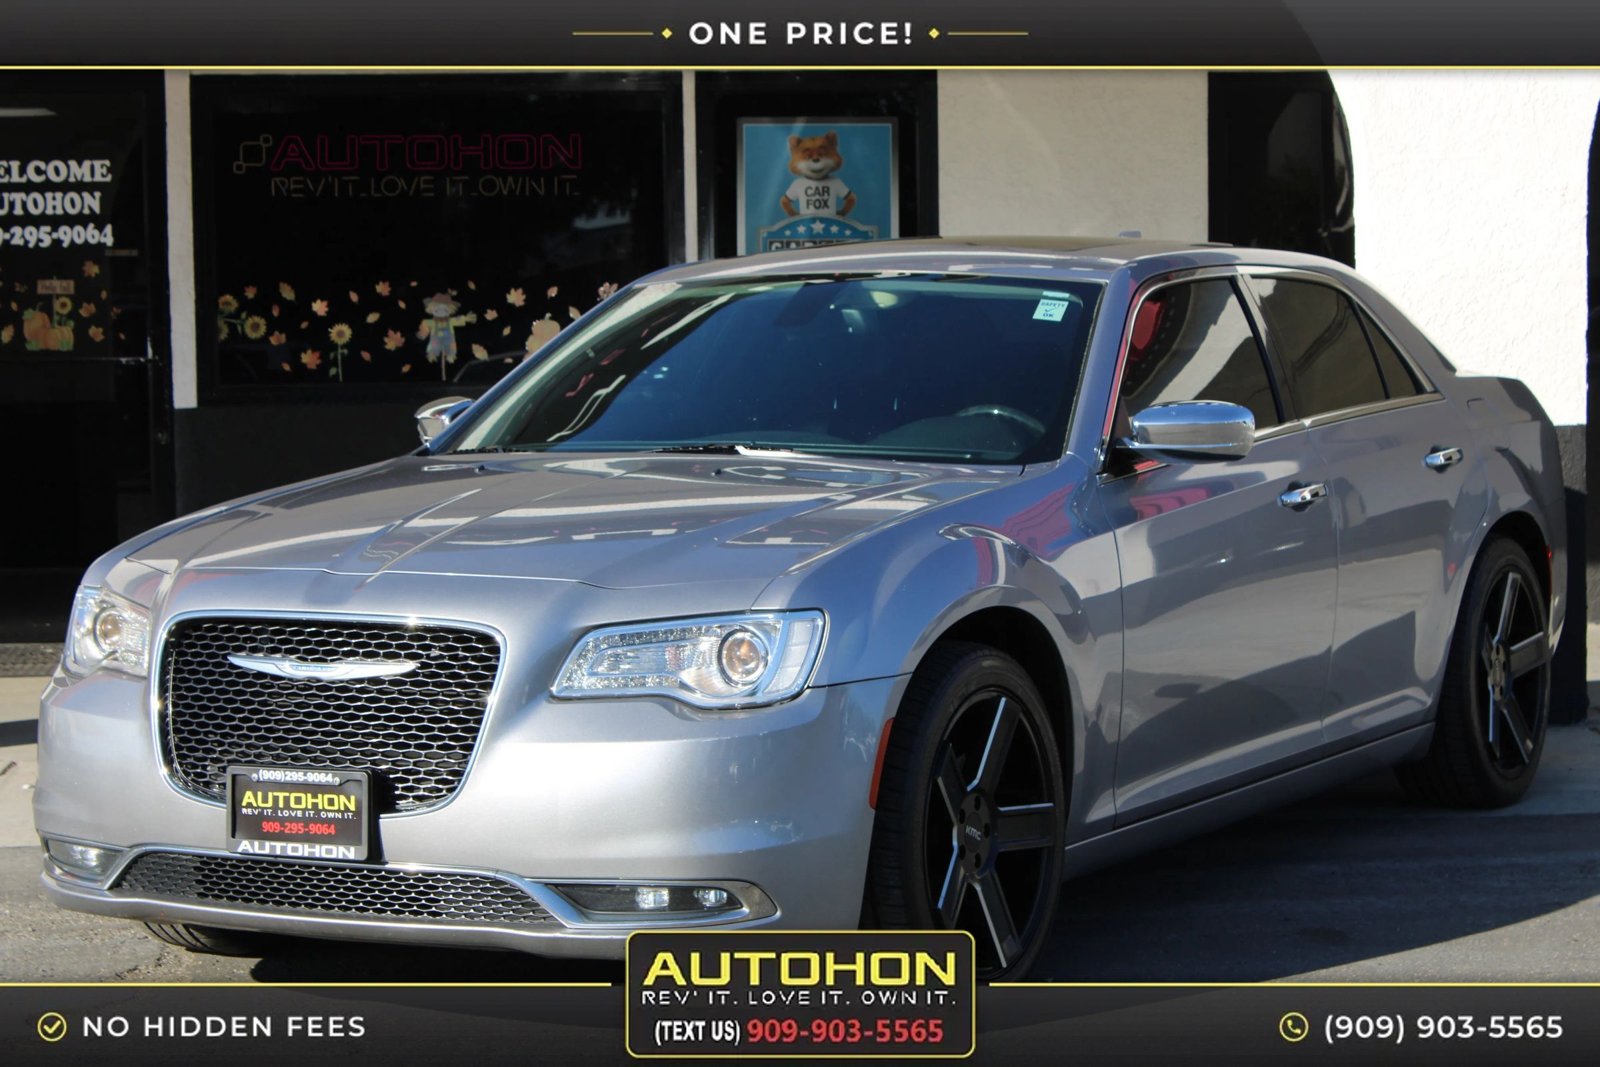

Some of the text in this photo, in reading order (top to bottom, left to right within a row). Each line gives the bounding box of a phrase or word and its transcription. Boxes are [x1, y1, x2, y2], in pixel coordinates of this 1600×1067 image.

[270, 134, 582, 171] AUTOHON
[804, 186, 831, 197] CAR
[806, 199, 830, 209] FOX
[0, 223, 114, 248] -295-9064
[258, 769, 334, 783] (909)295-9064
[241, 790, 356, 811] AUTOHON
[306, 810, 318, 818] IT.
[320, 811, 342, 819] OWN
[261, 821, 336, 835] 909-295-9064
[237, 840, 355, 859] AUTOHON
